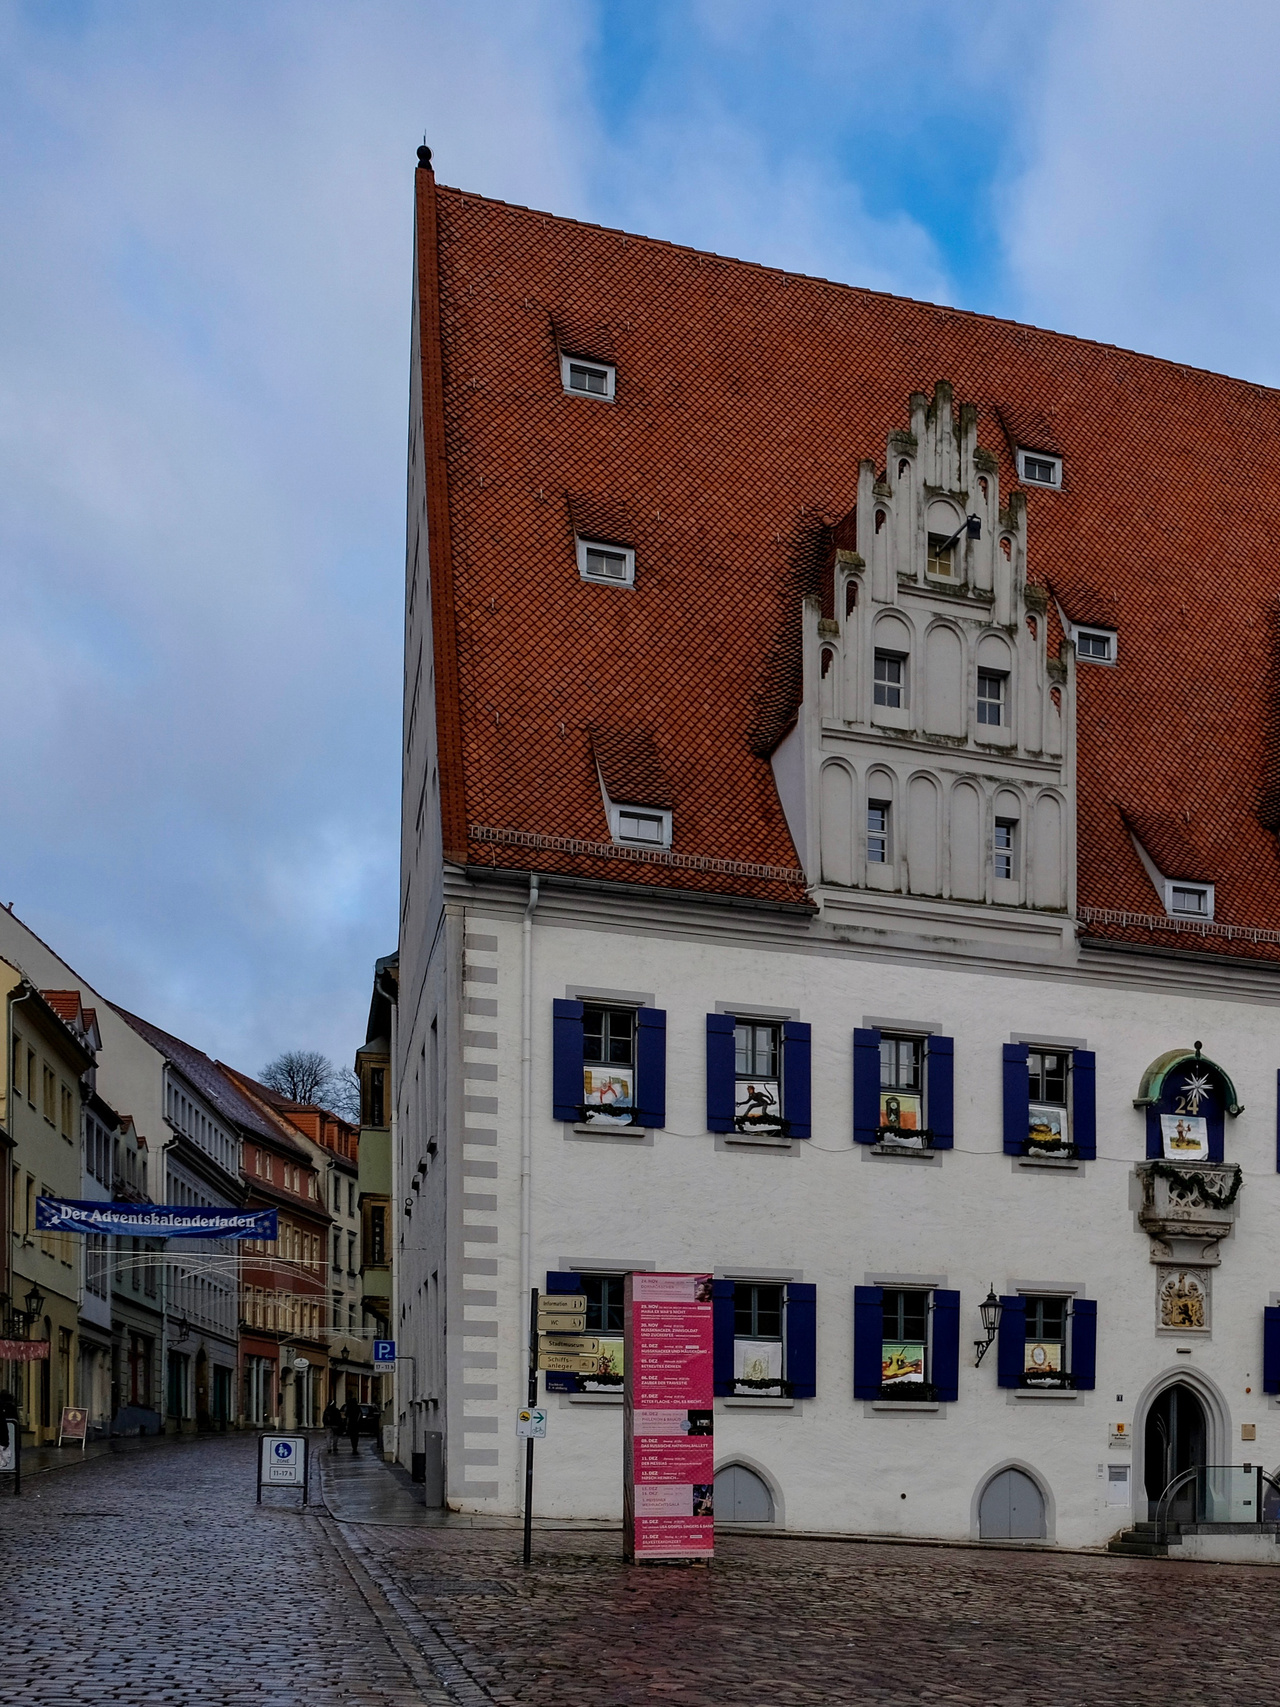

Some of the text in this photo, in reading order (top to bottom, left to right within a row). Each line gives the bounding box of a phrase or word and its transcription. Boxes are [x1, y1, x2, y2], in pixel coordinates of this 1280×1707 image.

[1175, 1096, 1199, 1115] 24
[60, 1206, 255, 1228] Der Adventskalenderladen
[379, 1343, 390, 1359] P
